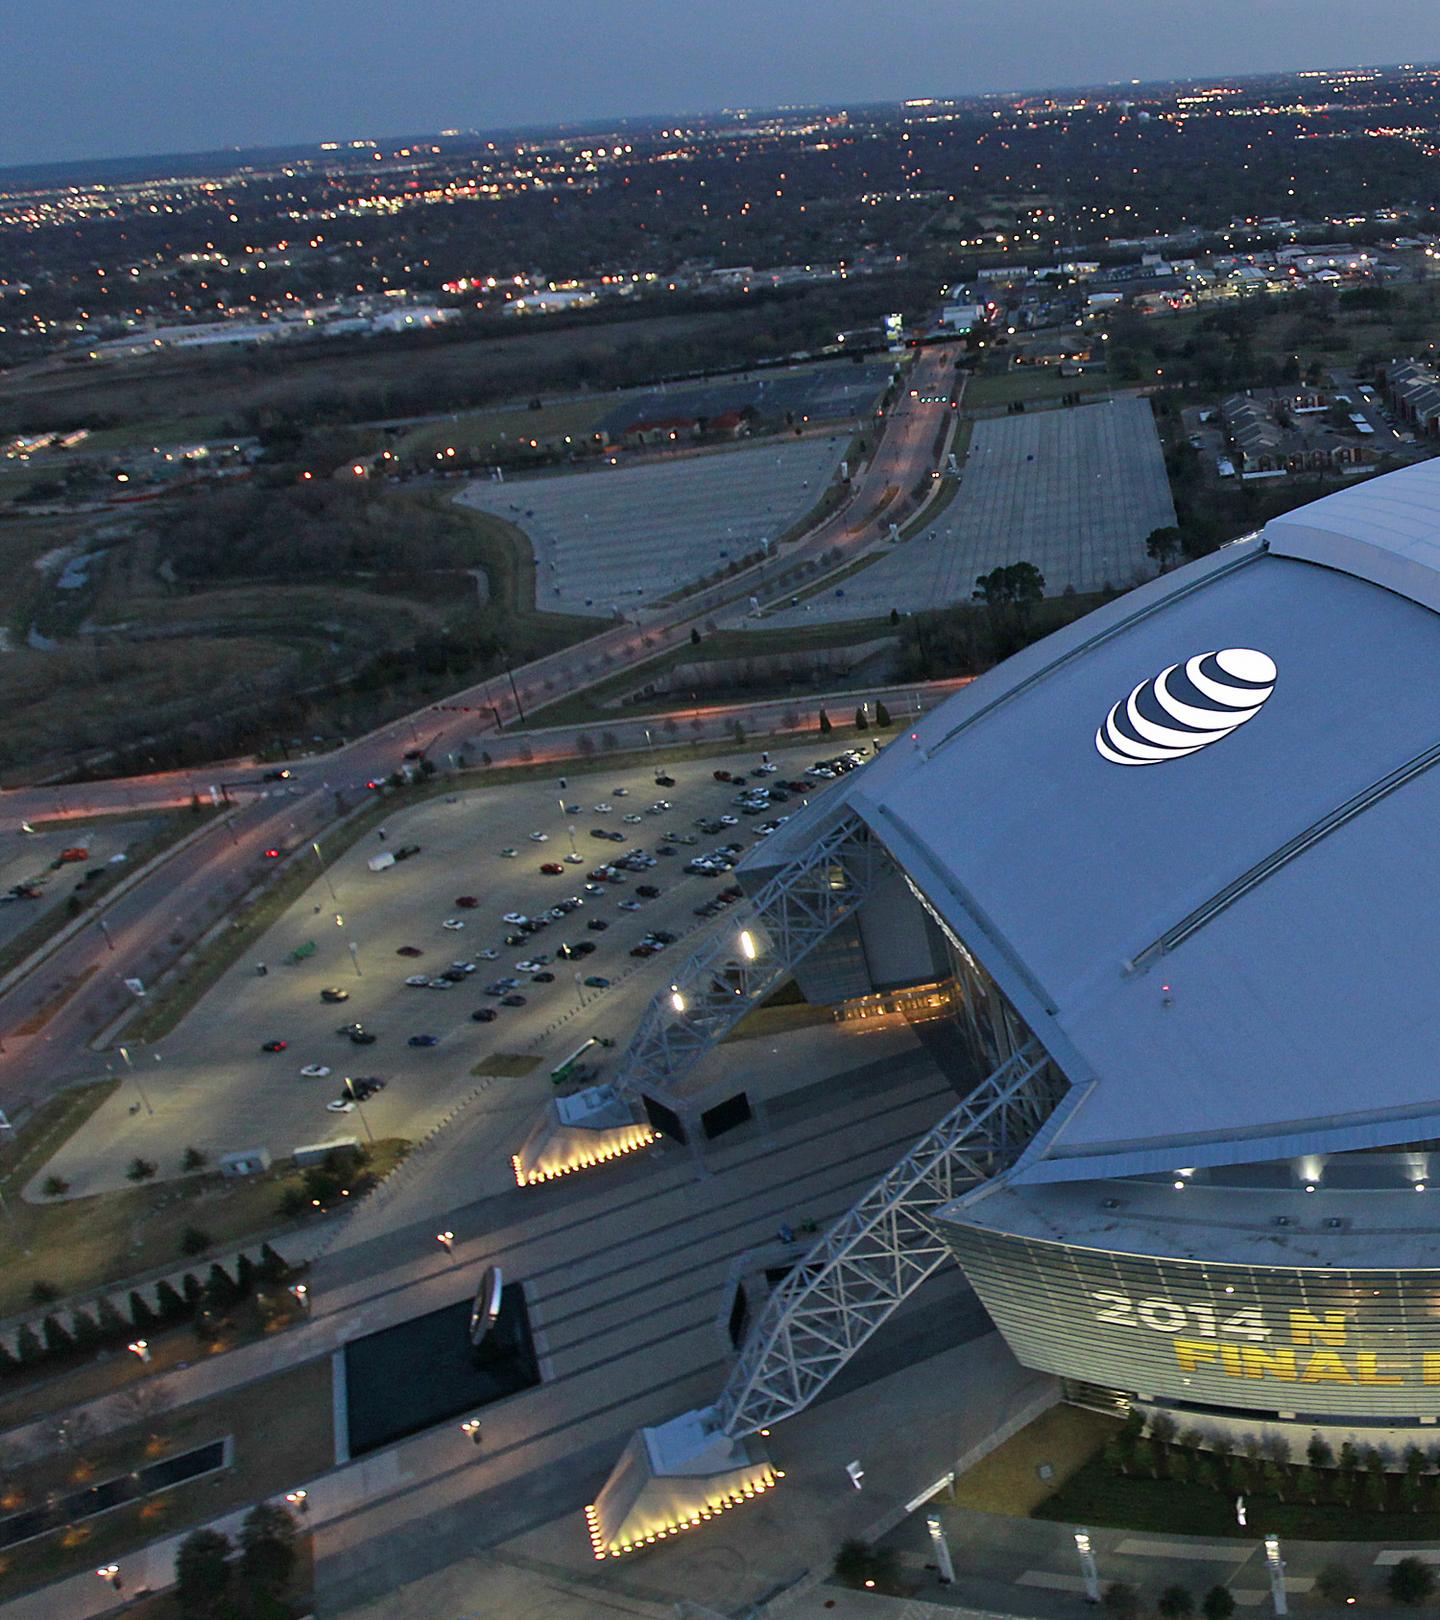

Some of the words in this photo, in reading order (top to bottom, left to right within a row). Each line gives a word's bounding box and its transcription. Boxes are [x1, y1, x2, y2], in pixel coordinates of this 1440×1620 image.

[1092, 1289, 1272, 1341] 2014
[1289, 1308, 1347, 1346] N
[1173, 1337, 1404, 1386] FINAL
